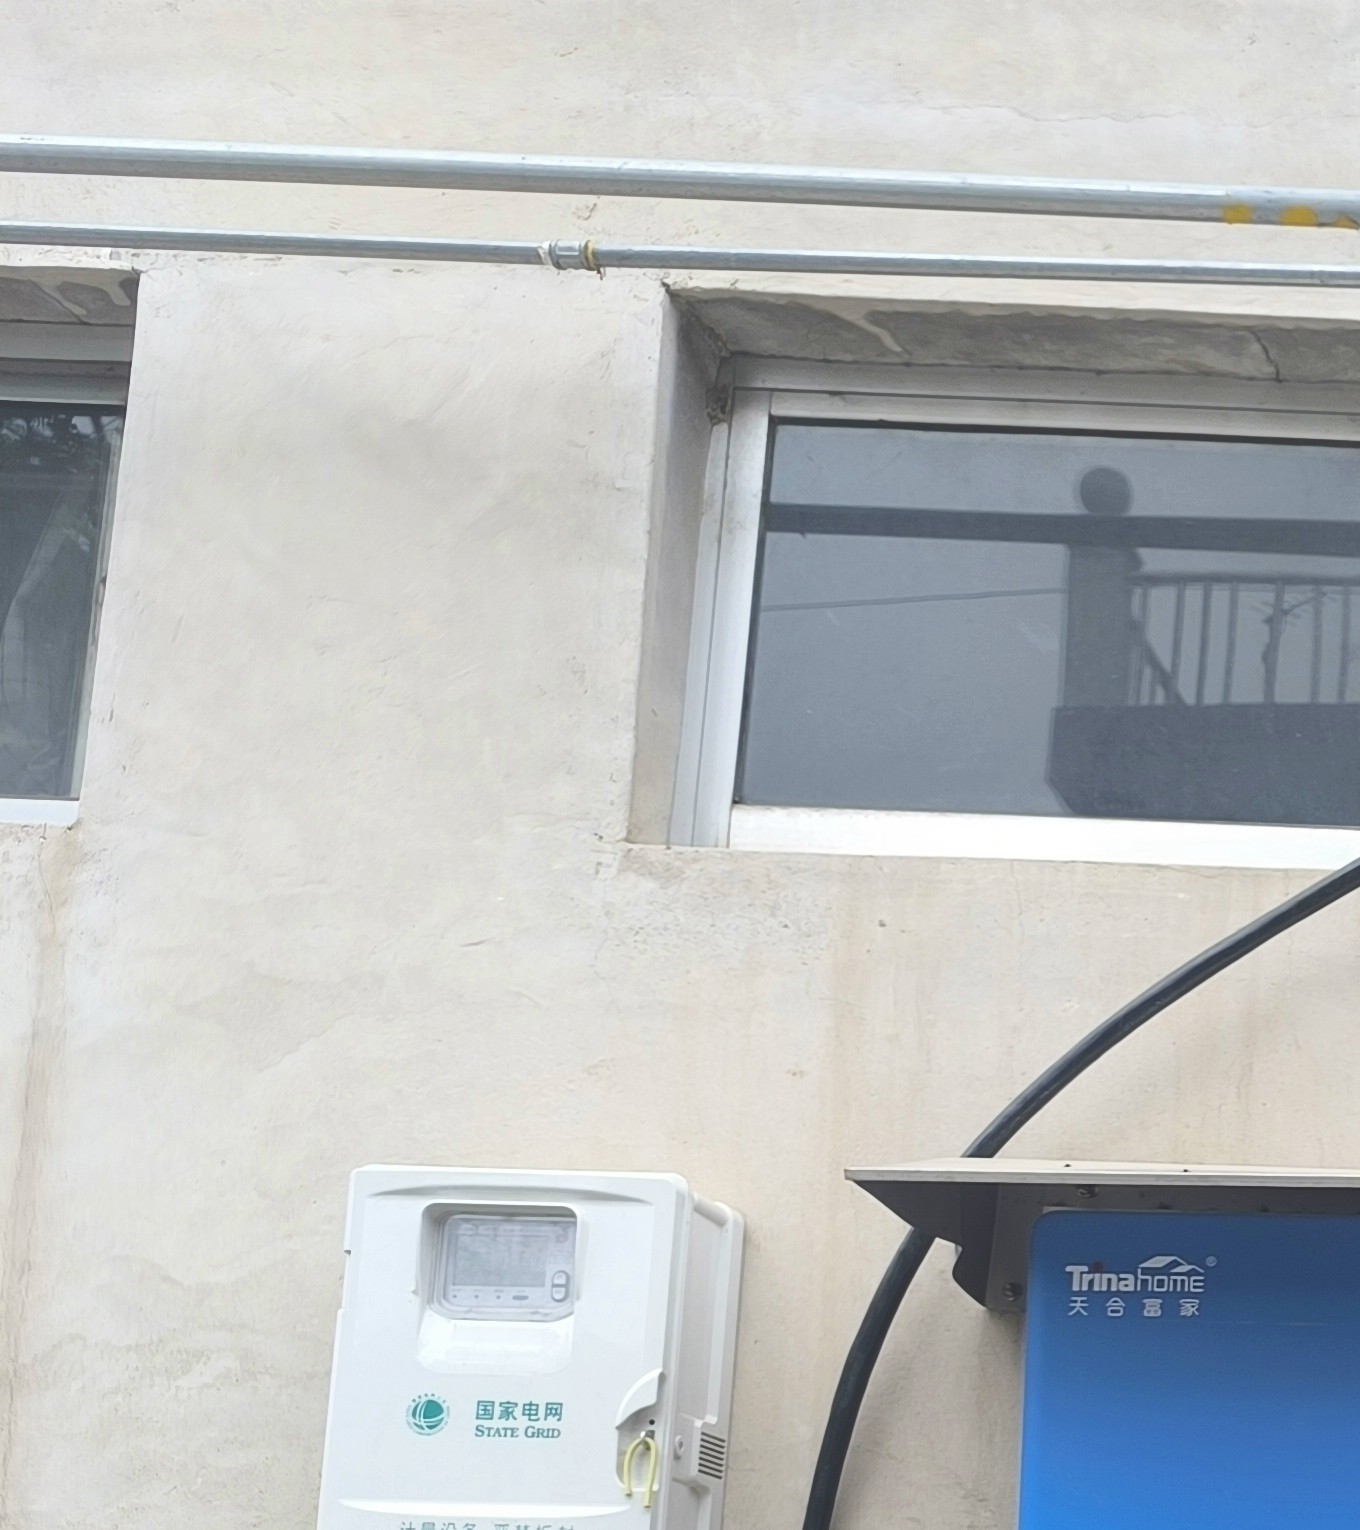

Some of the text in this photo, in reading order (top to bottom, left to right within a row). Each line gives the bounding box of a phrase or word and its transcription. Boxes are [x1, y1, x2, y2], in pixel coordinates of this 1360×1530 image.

[1068, 1296, 1200, 1318] 天合富家
[475, 1400, 563, 1422] 国家电网
[475, 1424, 561, 1439] STATE GRID
